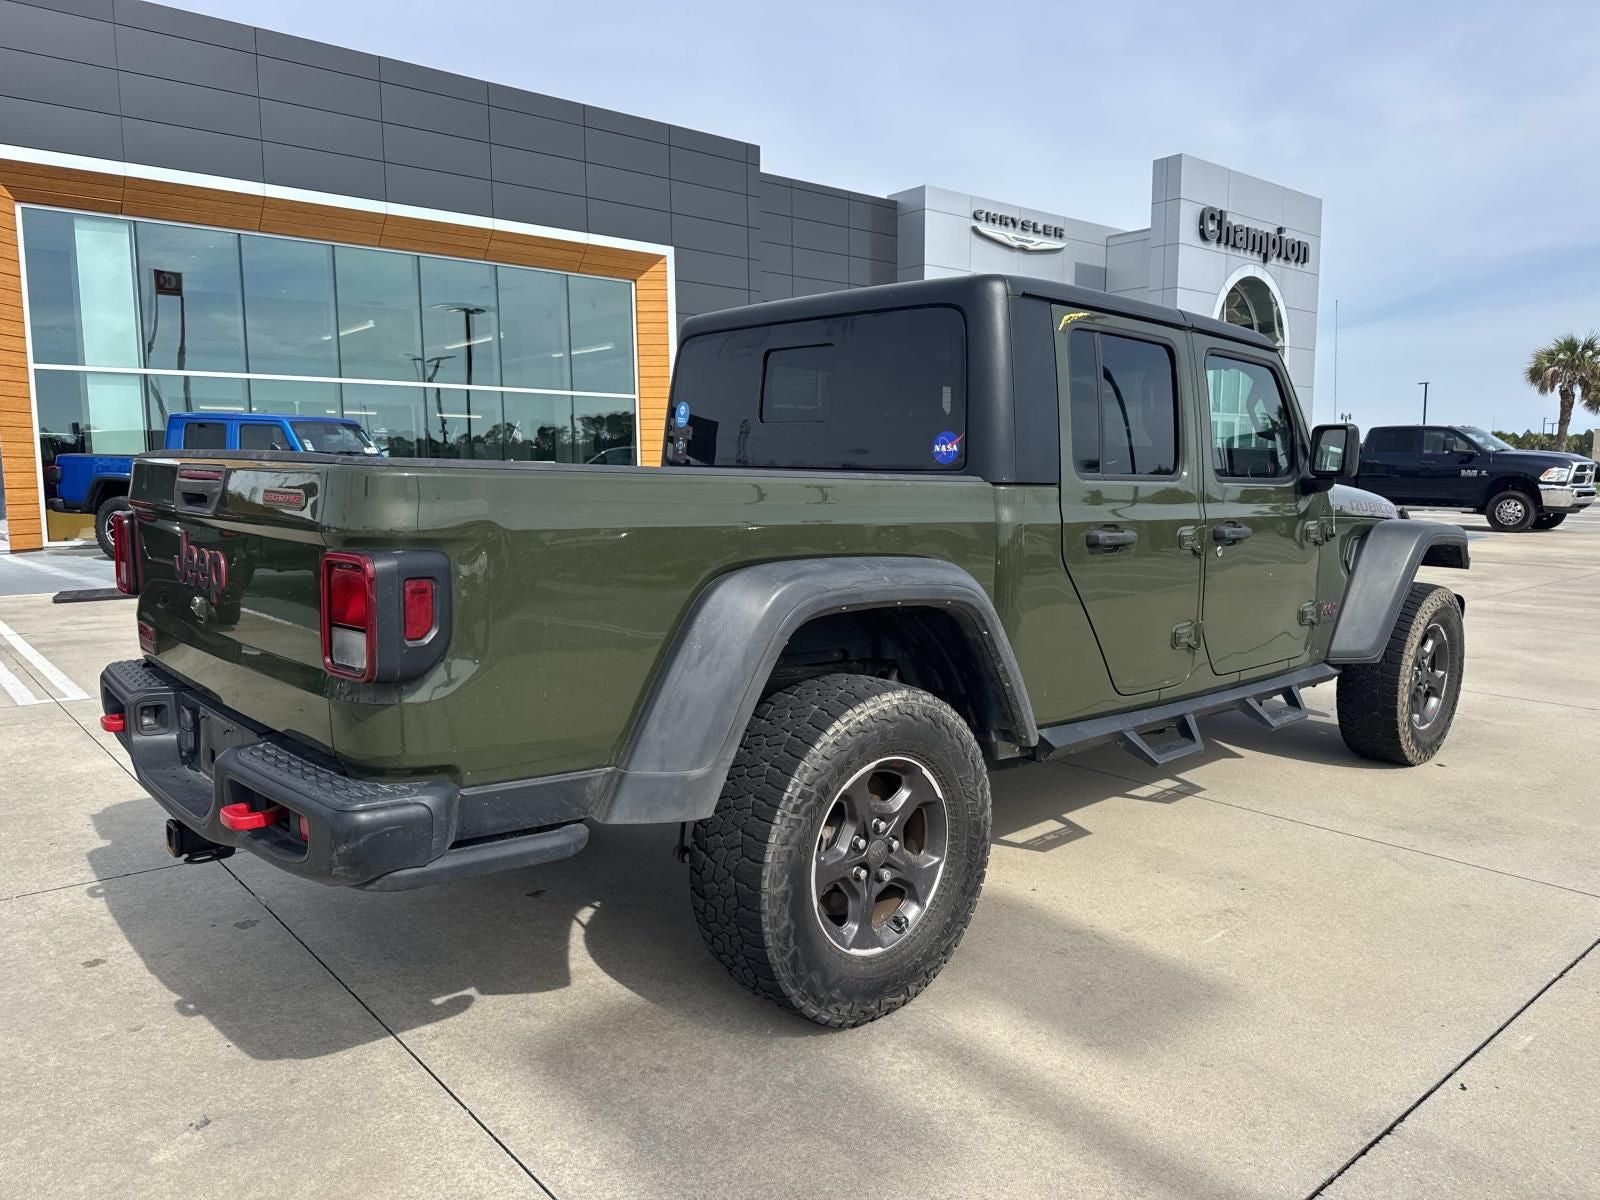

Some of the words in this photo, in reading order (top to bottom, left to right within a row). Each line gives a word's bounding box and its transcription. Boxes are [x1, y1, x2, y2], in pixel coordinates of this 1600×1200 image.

[973, 209, 1065, 239] CHRYSLER
[1199, 206, 1310, 264] Champion
[934, 443, 958, 452] NASA
[174, 529, 228, 607] Jeep
